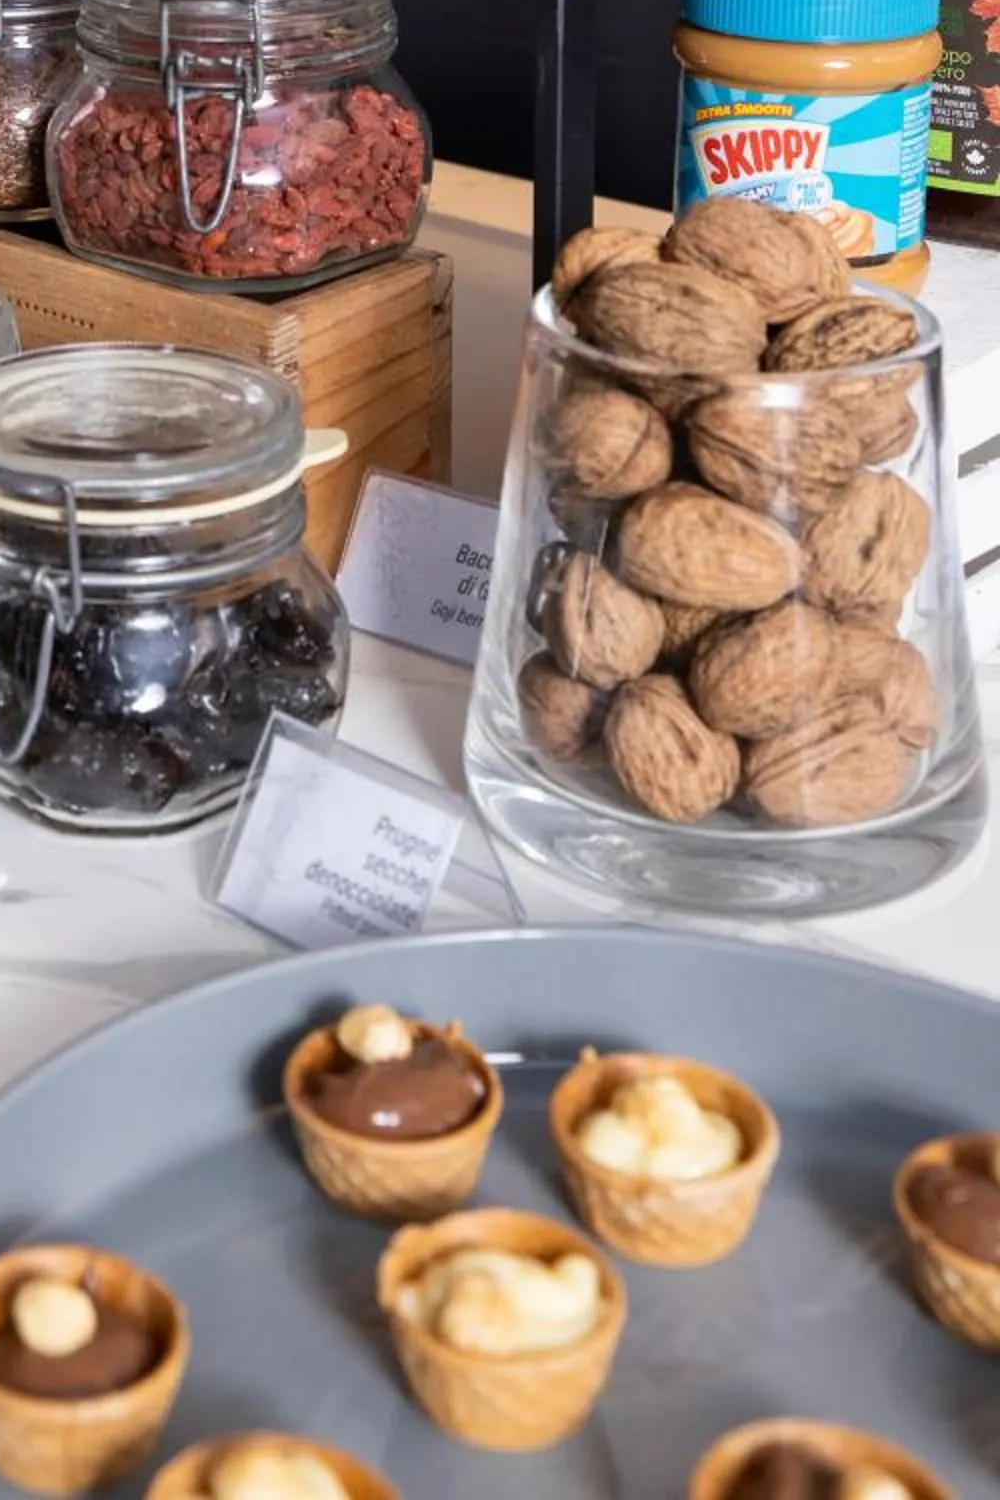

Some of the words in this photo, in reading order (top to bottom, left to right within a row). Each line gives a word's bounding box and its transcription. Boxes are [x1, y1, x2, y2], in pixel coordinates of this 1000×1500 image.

[733, 102, 793, 117] SMOOTH
[703, 128, 823, 185] SKIPPY
[455, 542, 493, 571] Bacc
[457, 574, 478, 597] di
[430, 599, 456, 624] Goji
[456, 609, 485, 628] berr
